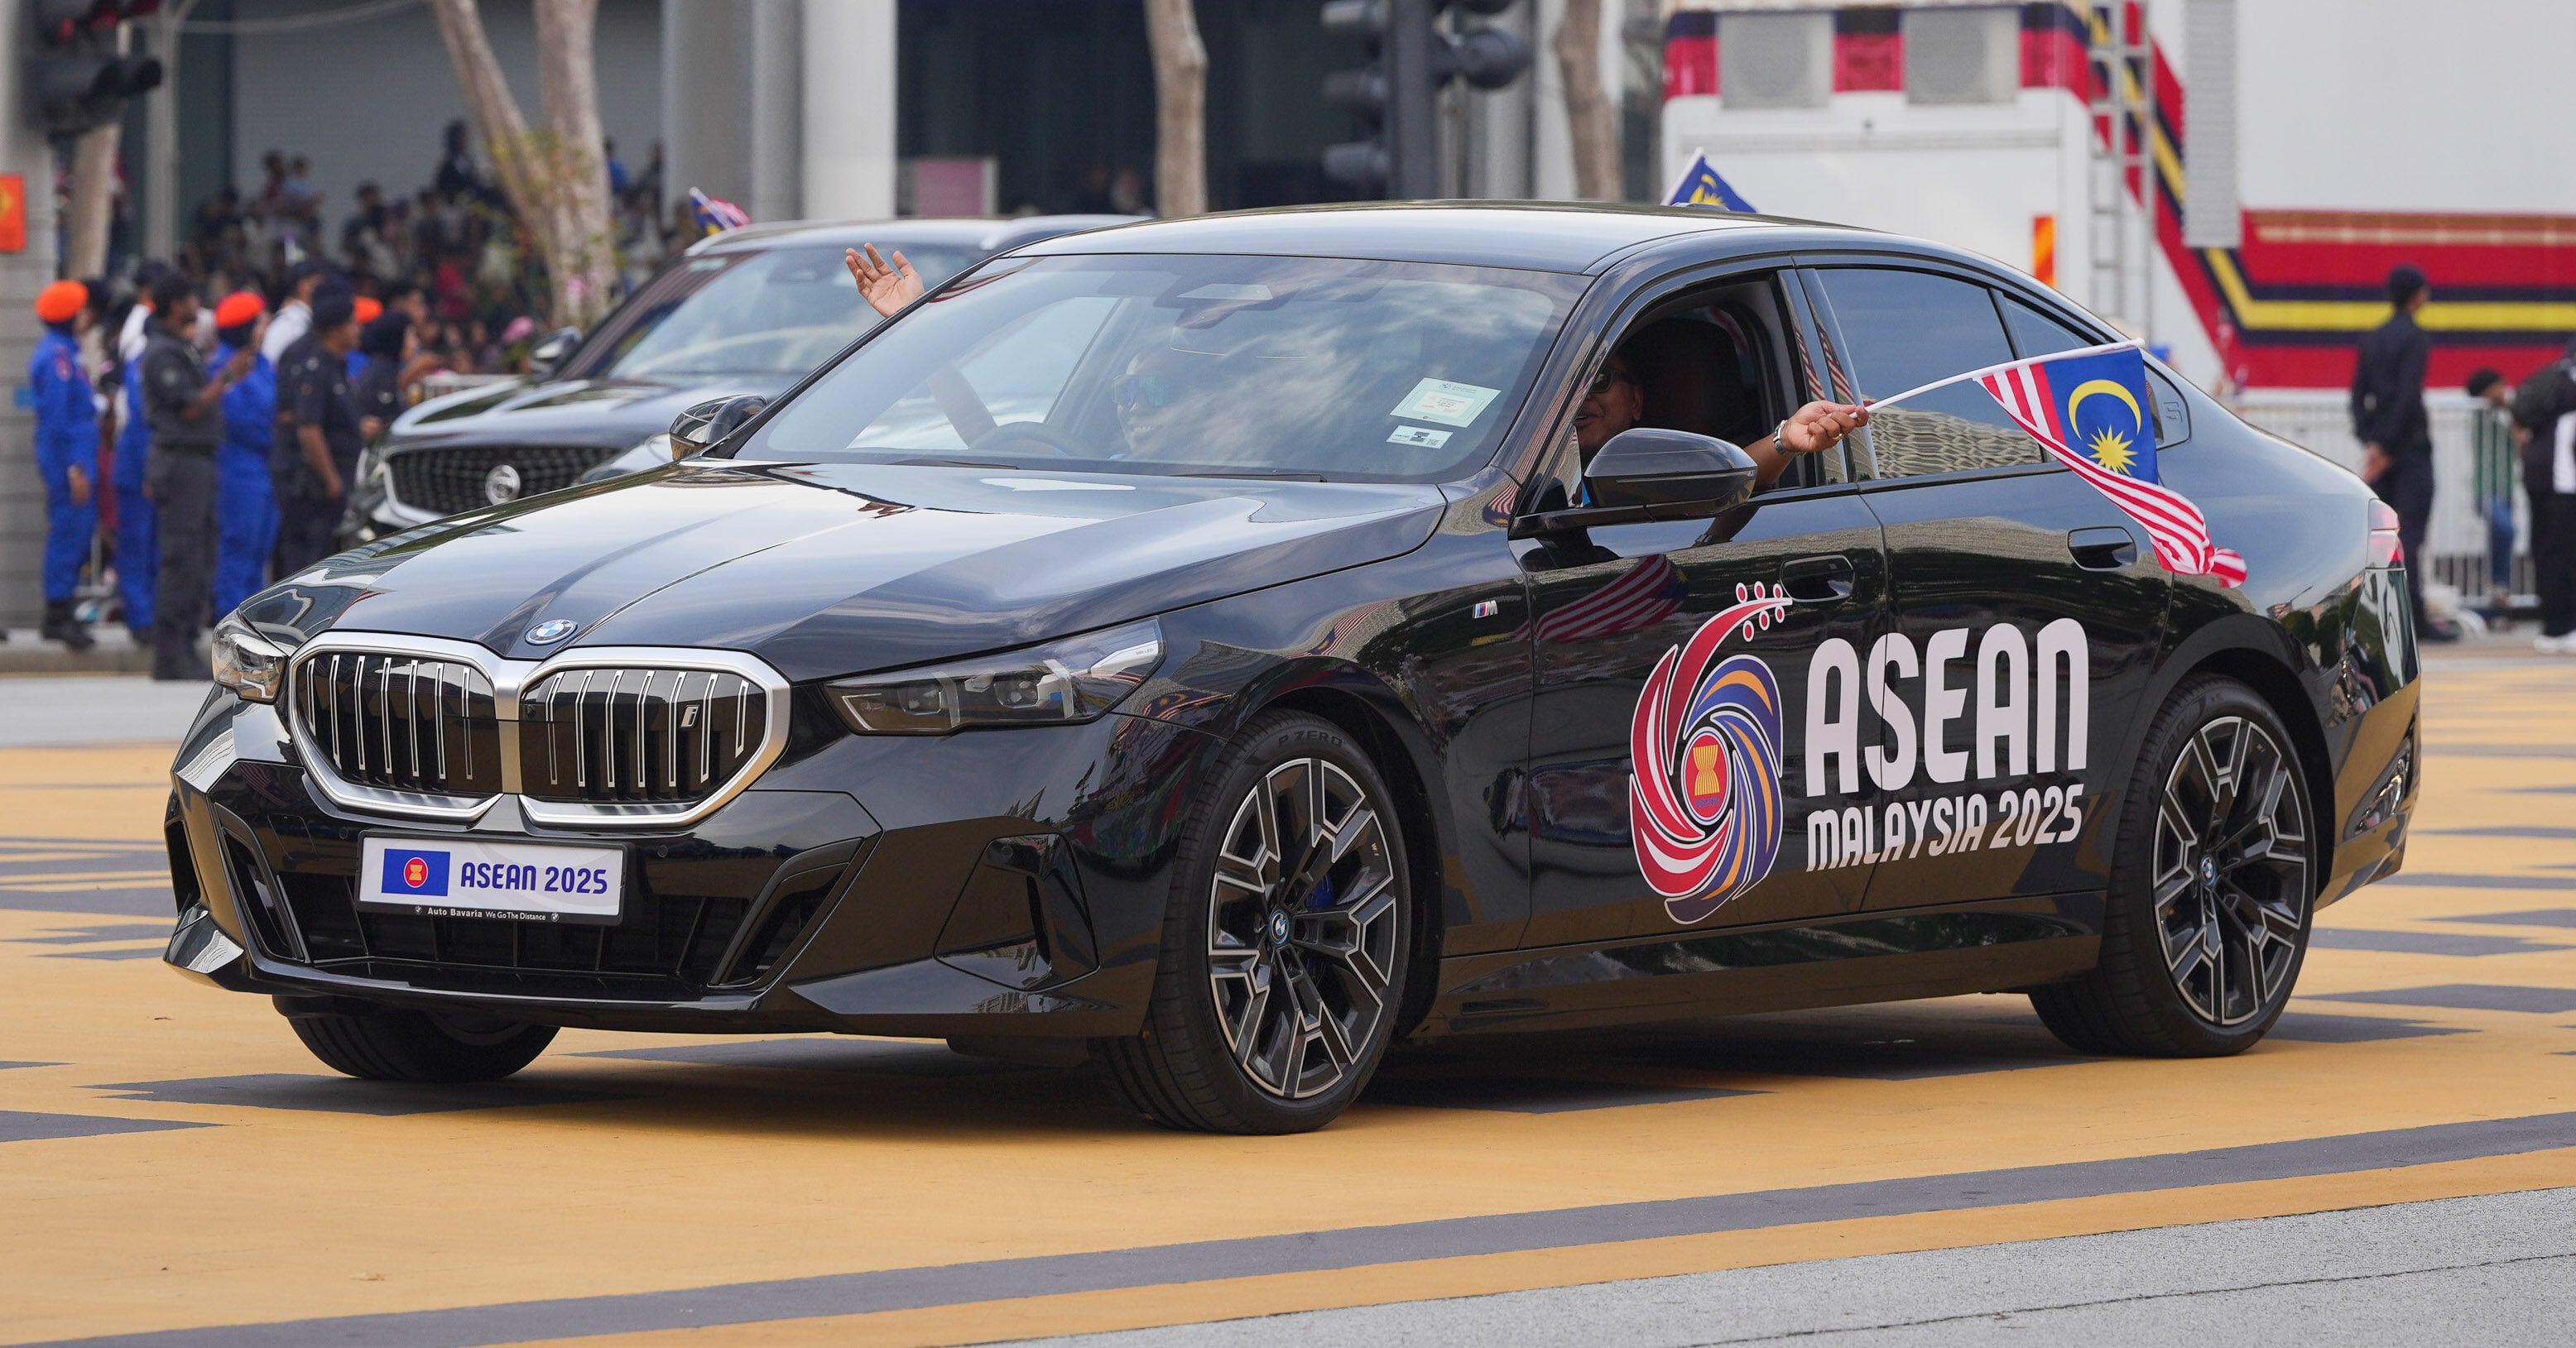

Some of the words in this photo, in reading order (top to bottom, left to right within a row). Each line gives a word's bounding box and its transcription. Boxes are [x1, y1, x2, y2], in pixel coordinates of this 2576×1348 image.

[1805, 617, 2089, 798] ASEAN
[1294, 730, 1343, 747] ZERO
[1806, 793, 1987, 873] MALAYSIA
[1988, 784, 2084, 850] 2025
[461, 861, 536, 891] ASEAN
[544, 866, 608, 895] 2025
[427, 907, 447, 916] Auto
[450, 909, 483, 918] Bavaria
[497, 911, 506, 919] Go
[520, 913, 546, 921] Distance
